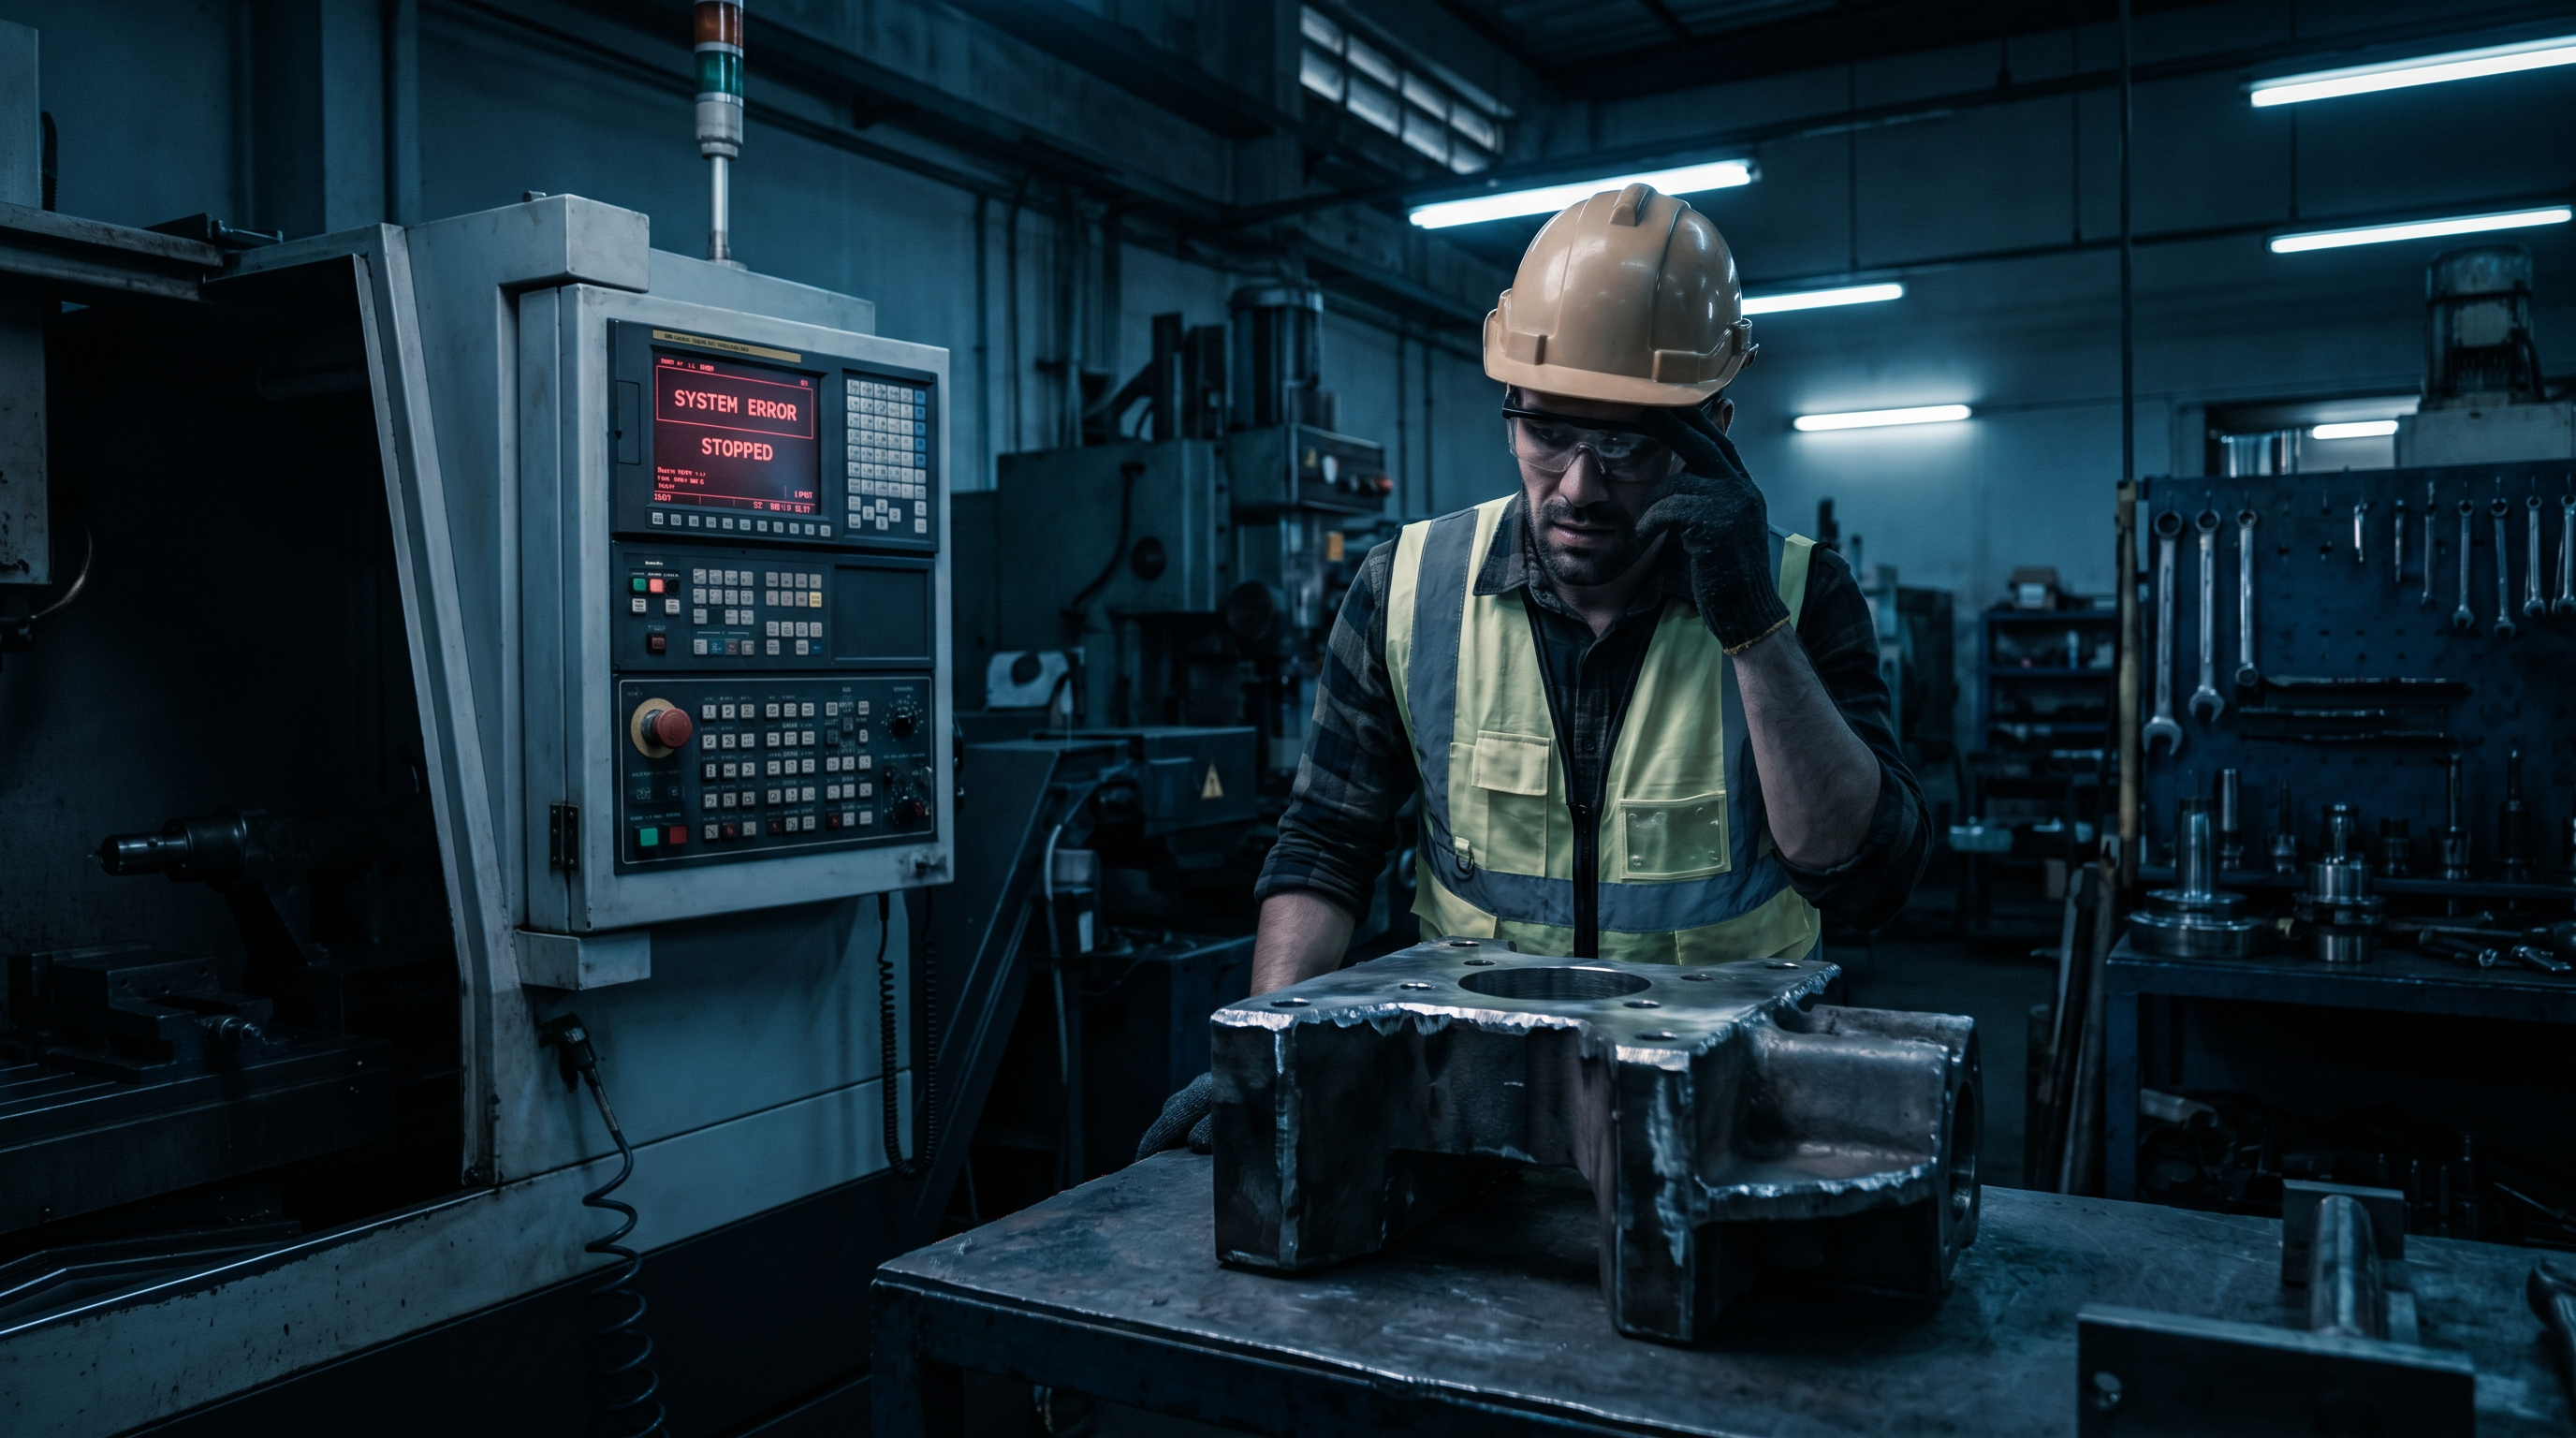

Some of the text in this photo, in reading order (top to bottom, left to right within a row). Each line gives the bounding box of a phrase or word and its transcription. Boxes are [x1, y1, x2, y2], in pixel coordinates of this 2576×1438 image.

[674, 389, 798, 421] SYSTEM ERROR
[701, 437, 773, 462] STOPPED
